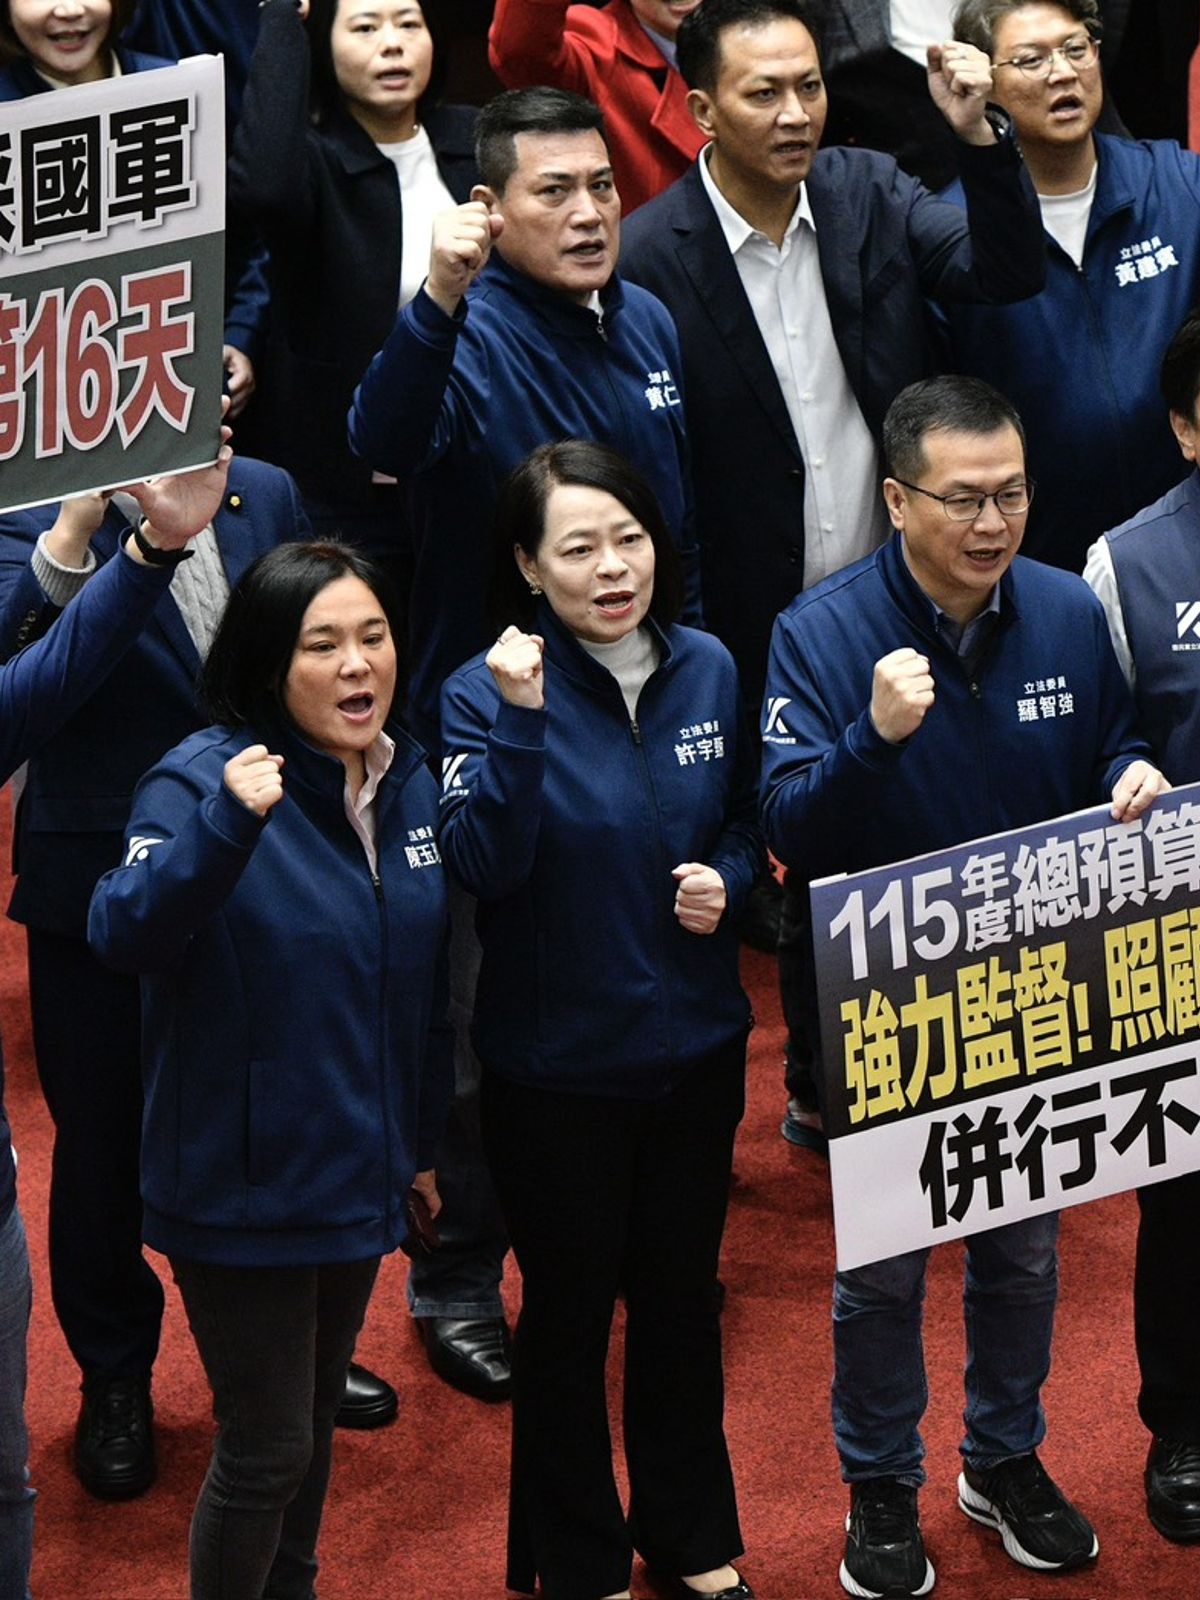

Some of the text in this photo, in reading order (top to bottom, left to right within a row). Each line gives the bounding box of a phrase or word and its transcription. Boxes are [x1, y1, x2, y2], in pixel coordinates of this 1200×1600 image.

[1023, 676, 1066, 694] 立法委員
[1017, 692, 1074, 722] 羅智強
